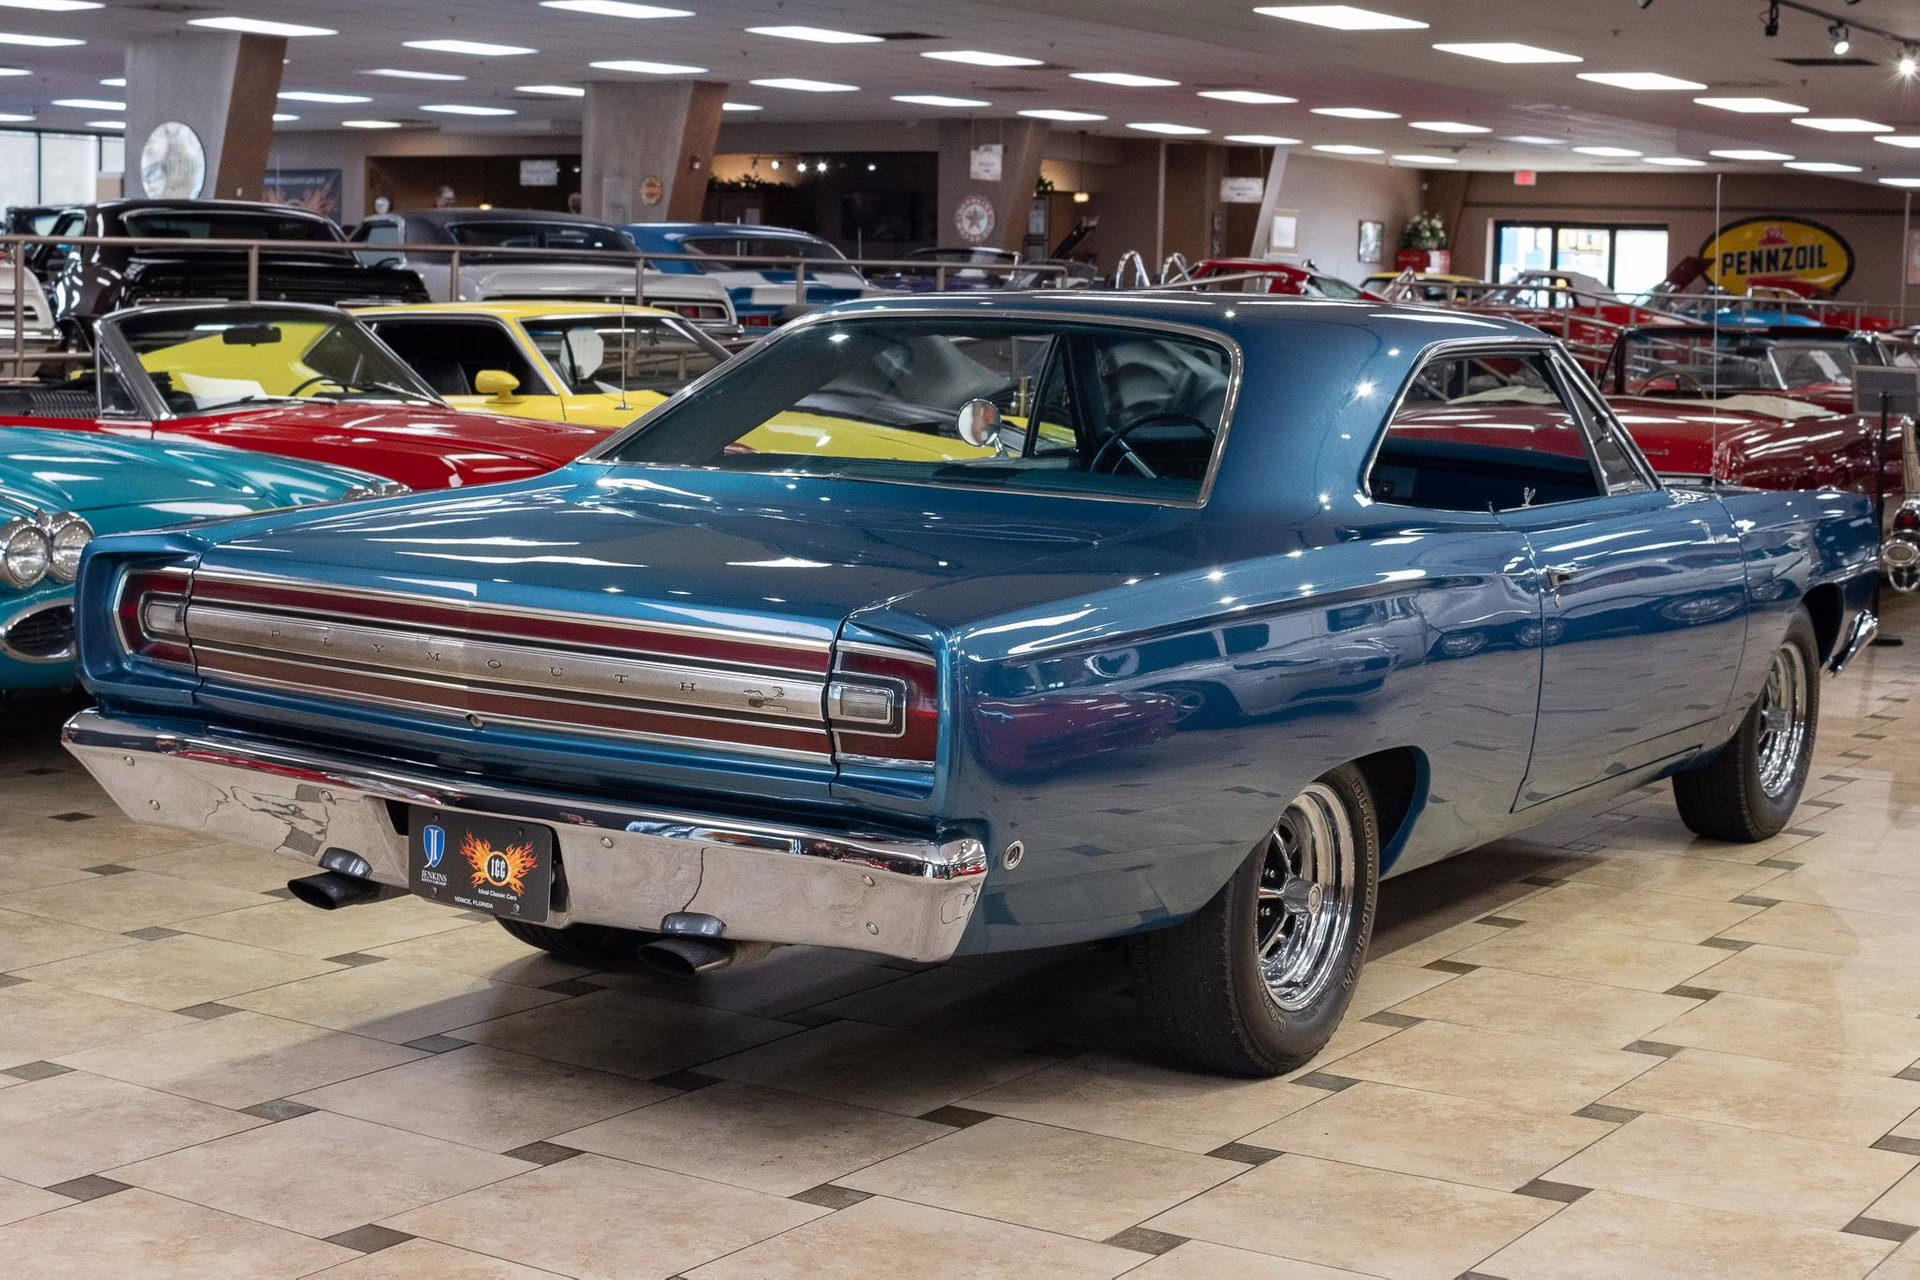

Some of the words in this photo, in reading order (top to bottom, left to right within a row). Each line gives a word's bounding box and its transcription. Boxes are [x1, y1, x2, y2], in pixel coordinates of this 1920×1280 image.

[1721, 244, 1828, 276] PENNZOIL
[271, 629, 696, 693] PLYMOUTH
[421, 869, 447, 882] JENKINS
[478, 888, 490, 896] Ideal
[490, 890, 506, 899] Classic
[506, 893, 517, 901] Cars
[472, 899, 494, 909] FLORIDA
